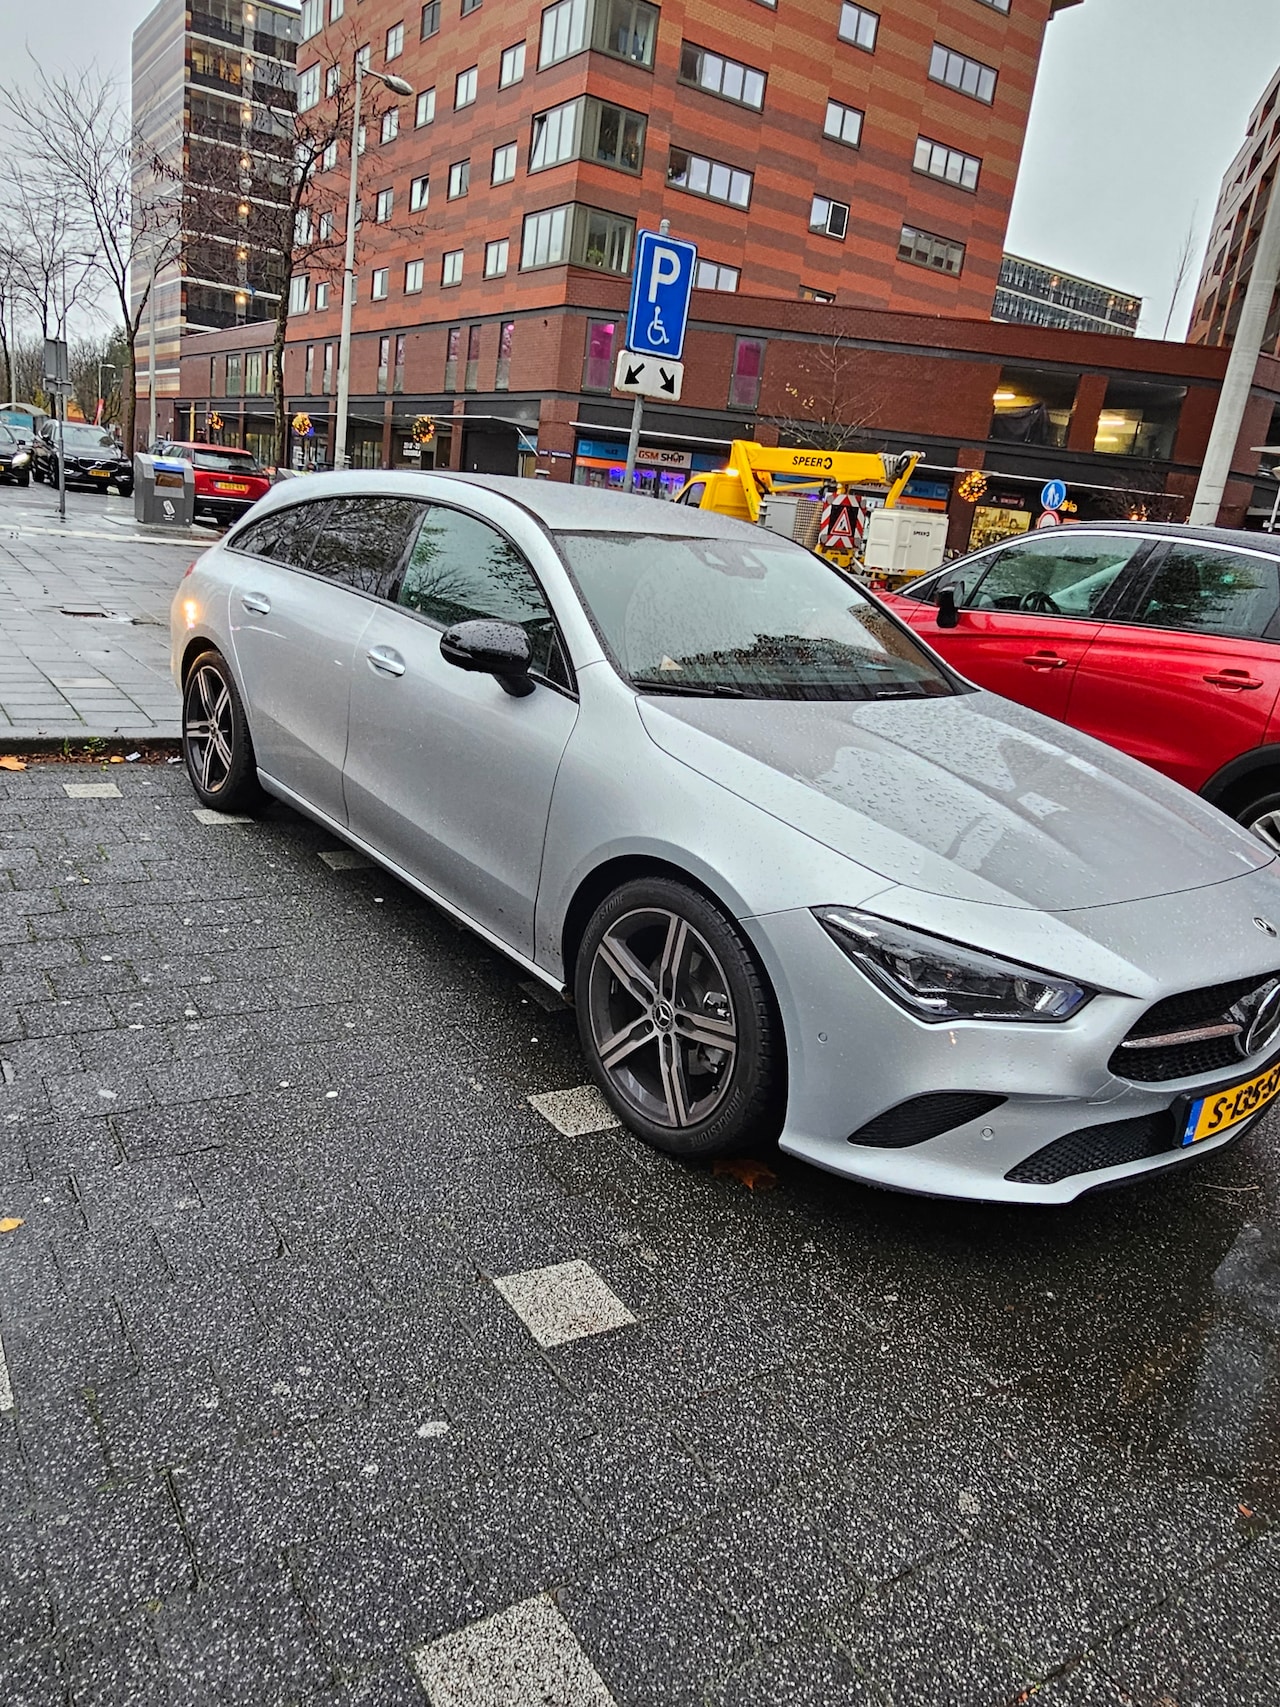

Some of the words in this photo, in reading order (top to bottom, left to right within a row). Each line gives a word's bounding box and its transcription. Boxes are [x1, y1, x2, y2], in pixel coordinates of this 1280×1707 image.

[648, 246, 681, 303] P
[638, 450, 659, 460] GSM
[660, 452, 685, 464] SHOP
